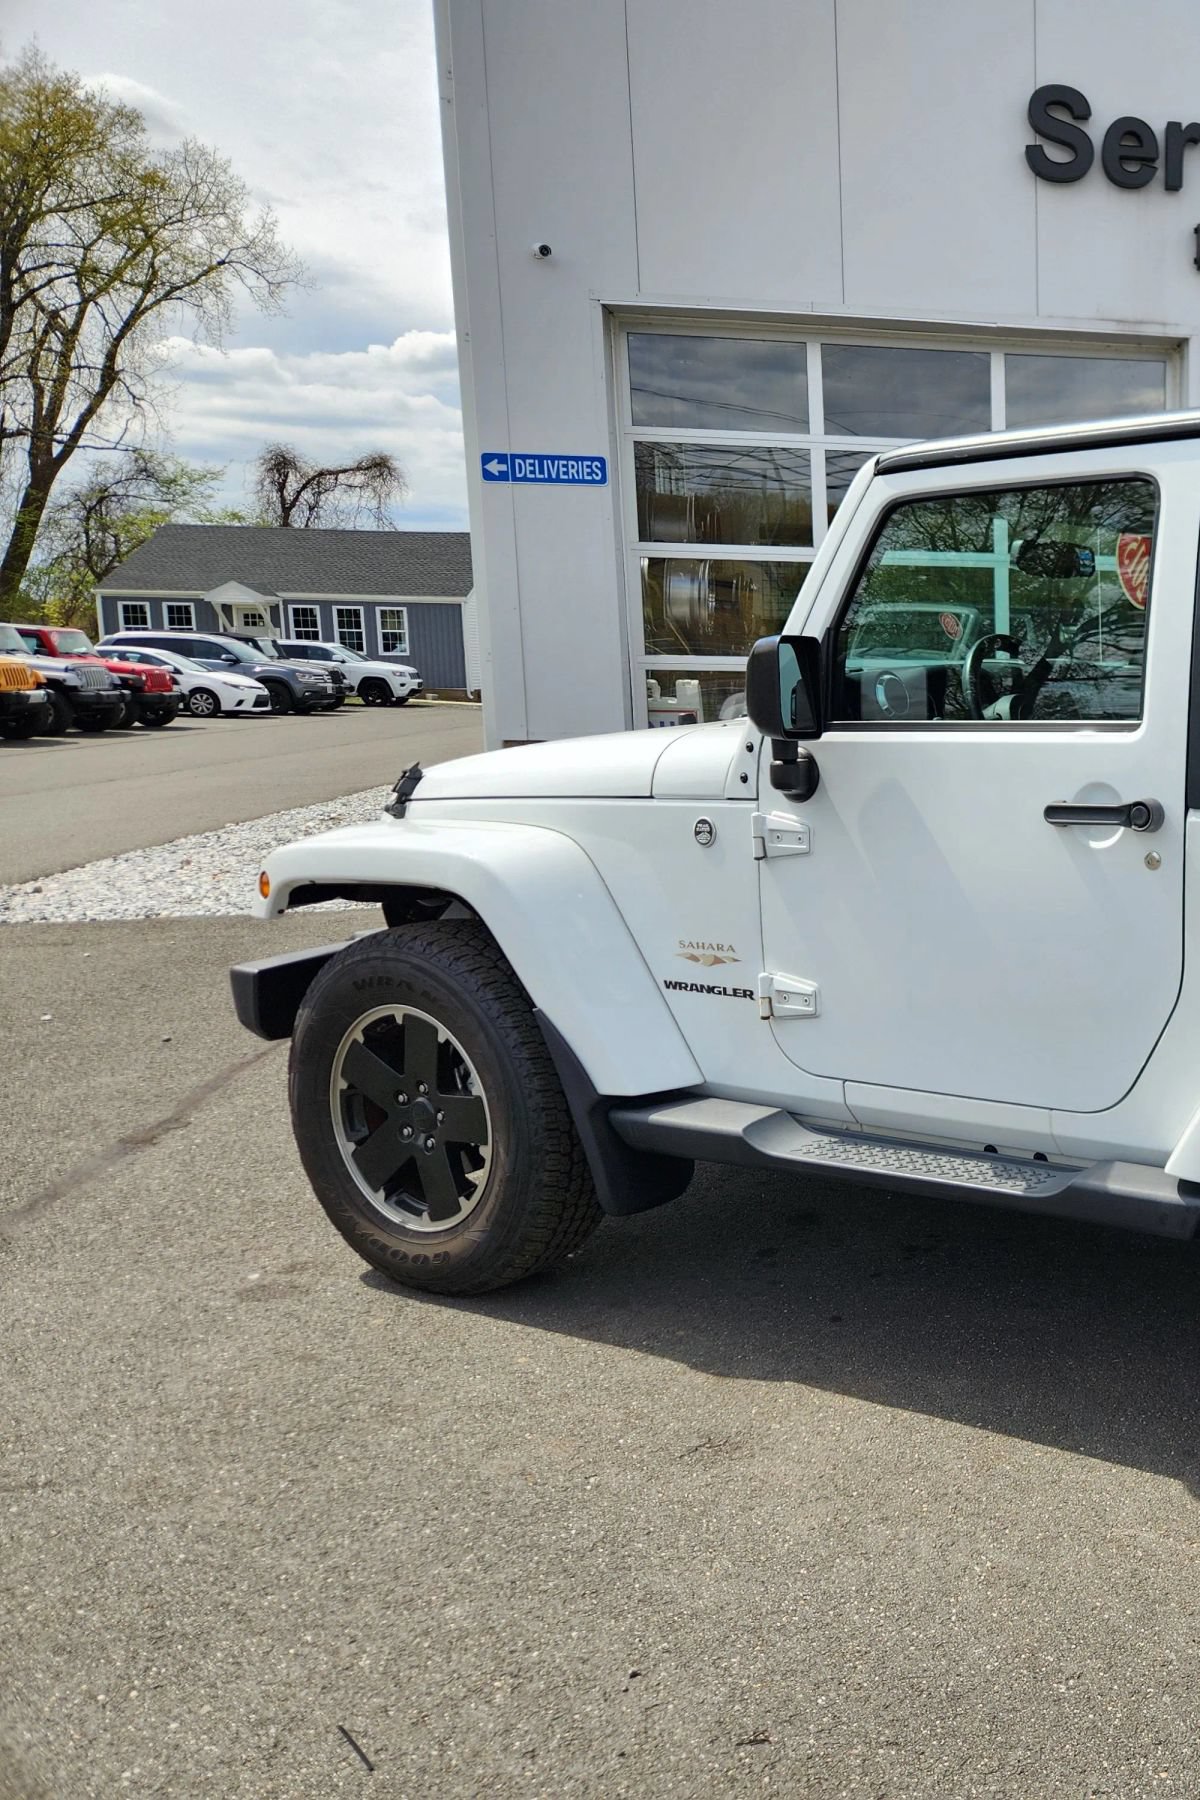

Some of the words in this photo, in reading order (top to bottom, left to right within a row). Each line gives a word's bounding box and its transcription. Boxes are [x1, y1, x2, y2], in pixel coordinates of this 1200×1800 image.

[514, 458, 602, 480] DELIVERIES
[679, 940, 736, 953] SAHARA
[664, 980, 756, 1001] WRANGLER
